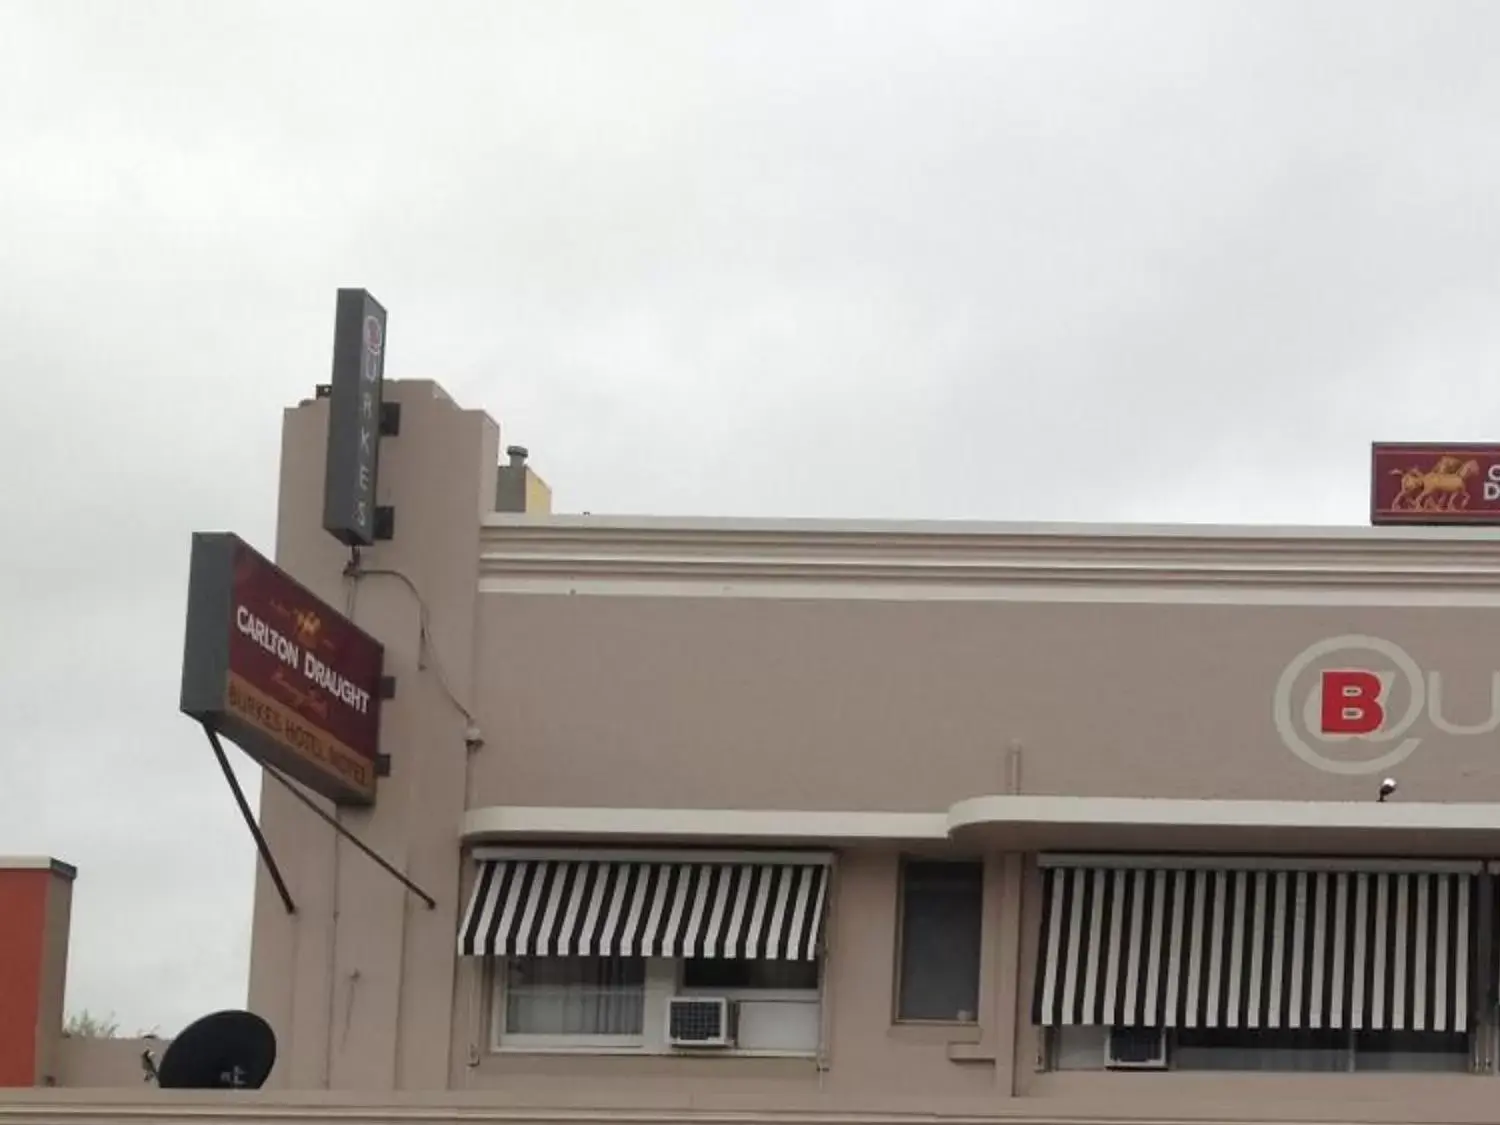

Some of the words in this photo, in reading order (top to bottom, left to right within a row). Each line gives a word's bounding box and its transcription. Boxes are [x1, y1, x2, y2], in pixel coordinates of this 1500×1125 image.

[236, 604, 300, 670] CARLTON
[304, 651, 371, 715] DRAUGHT
[285, 716, 326, 762] HOTEL
